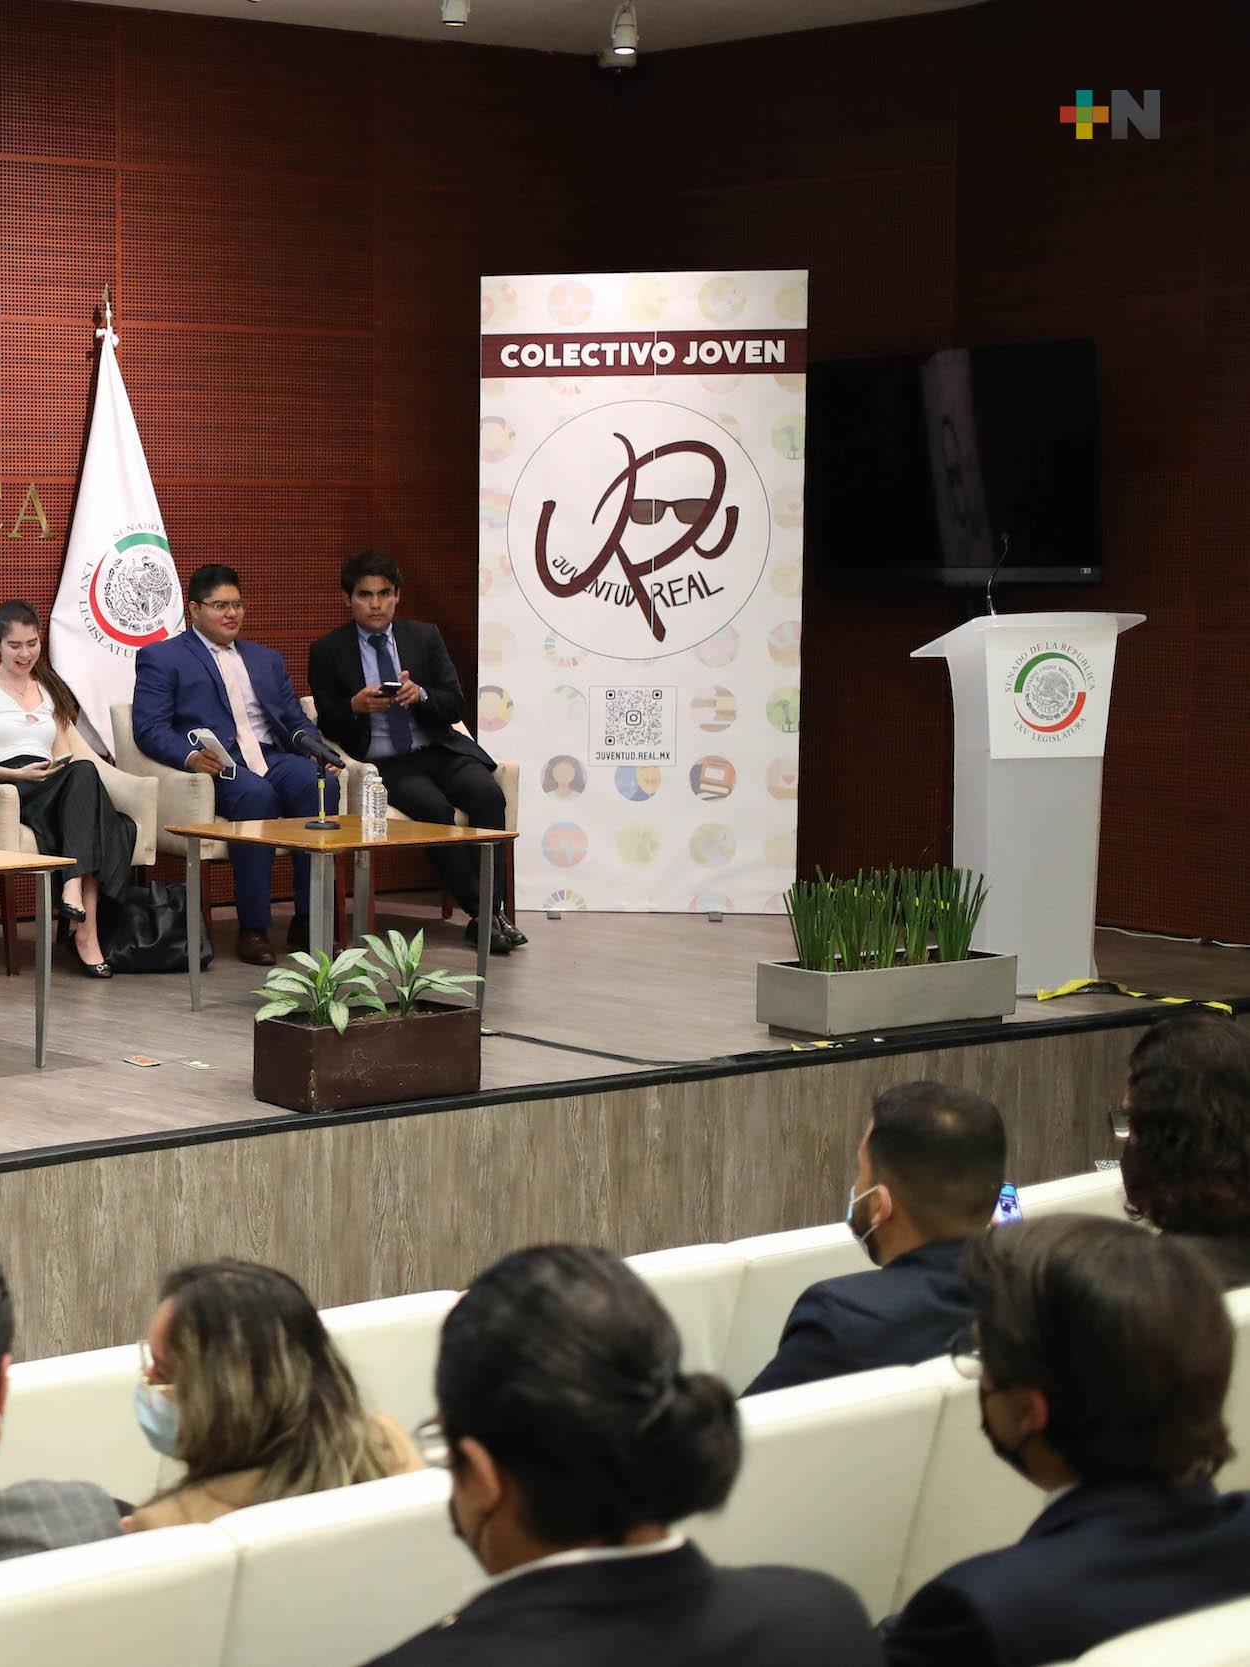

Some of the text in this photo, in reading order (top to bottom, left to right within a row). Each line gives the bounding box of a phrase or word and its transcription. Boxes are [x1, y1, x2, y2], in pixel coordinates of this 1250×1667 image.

[500, 339, 786, 368] COLECTIVO JOVEN
[651, 571, 725, 608] REAL
[1004, 649, 1029, 693] SENADO
[1029, 643, 1043, 654] DE
[1045, 641, 1059, 650] LA
[1032, 717, 1087, 743] LEGISLATURA
[595, 751, 671, 760] JUVENTUD.REAL.MX
